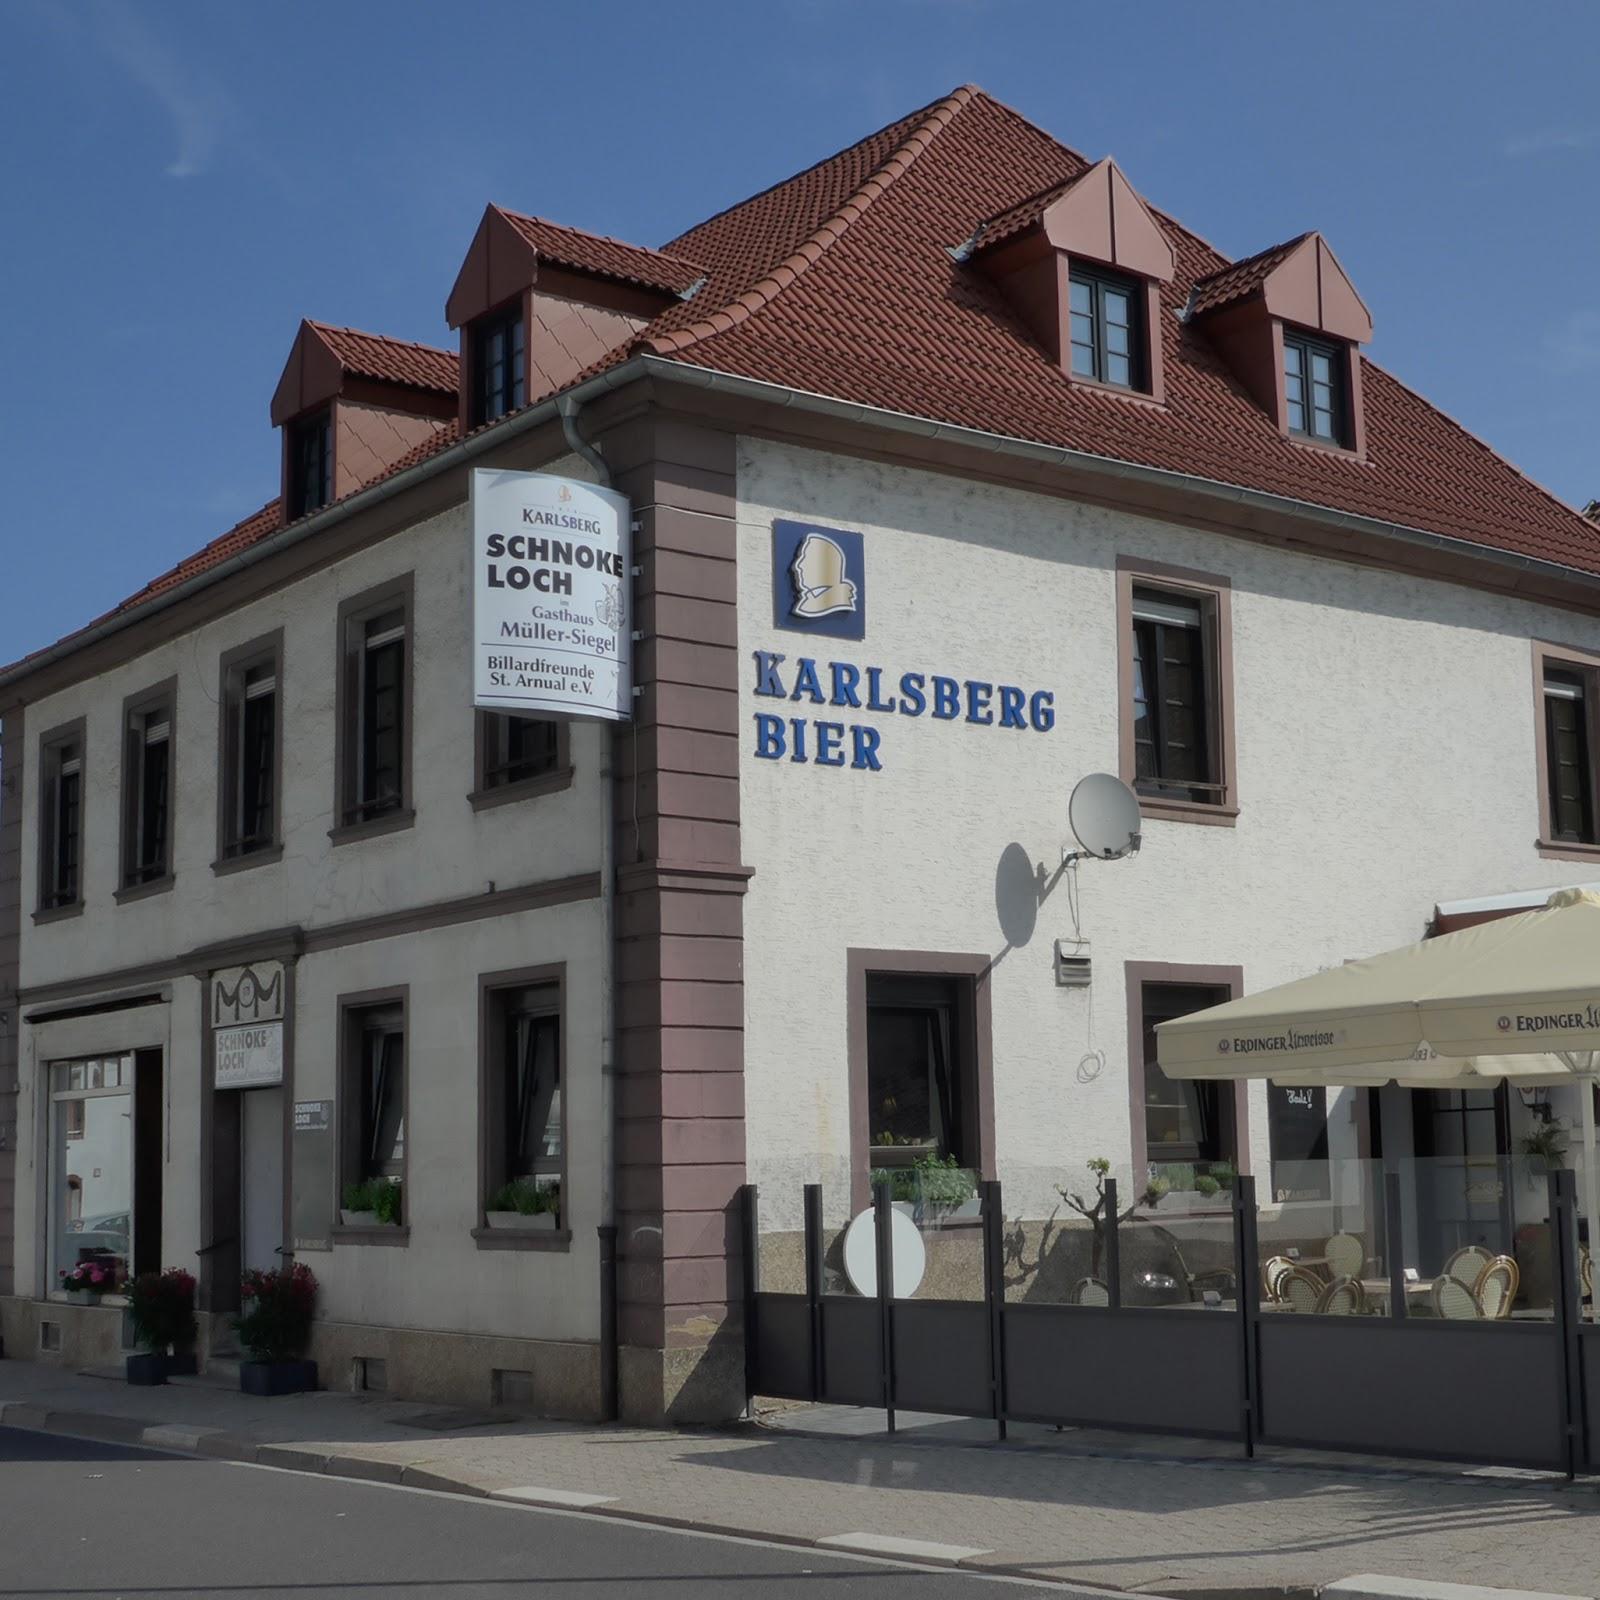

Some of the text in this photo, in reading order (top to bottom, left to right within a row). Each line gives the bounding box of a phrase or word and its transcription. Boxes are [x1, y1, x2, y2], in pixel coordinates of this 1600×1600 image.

[523, 508, 601, 535] KARLSBERG
[486, 533, 624, 578] SCHNOKE
[487, 564, 573, 595] LOCH
[532, 605, 595, 626] Gasthaus
[500, 621, 616, 654] Müller-Siegel
[488, 656, 595, 680] Billardfreunde
[490, 671, 593, 695] St. Arnual e.V.
[753, 650, 1056, 733] KARLSBERG
[753, 712, 883, 772] BIER
[1517, 1013, 1585, 1032] ERDINGER
[218, 1030, 266, 1052] SCHNOKE
[1233, 1037, 1286, 1053] ERDINGER
[218, 1051, 245, 1071] LOCH
